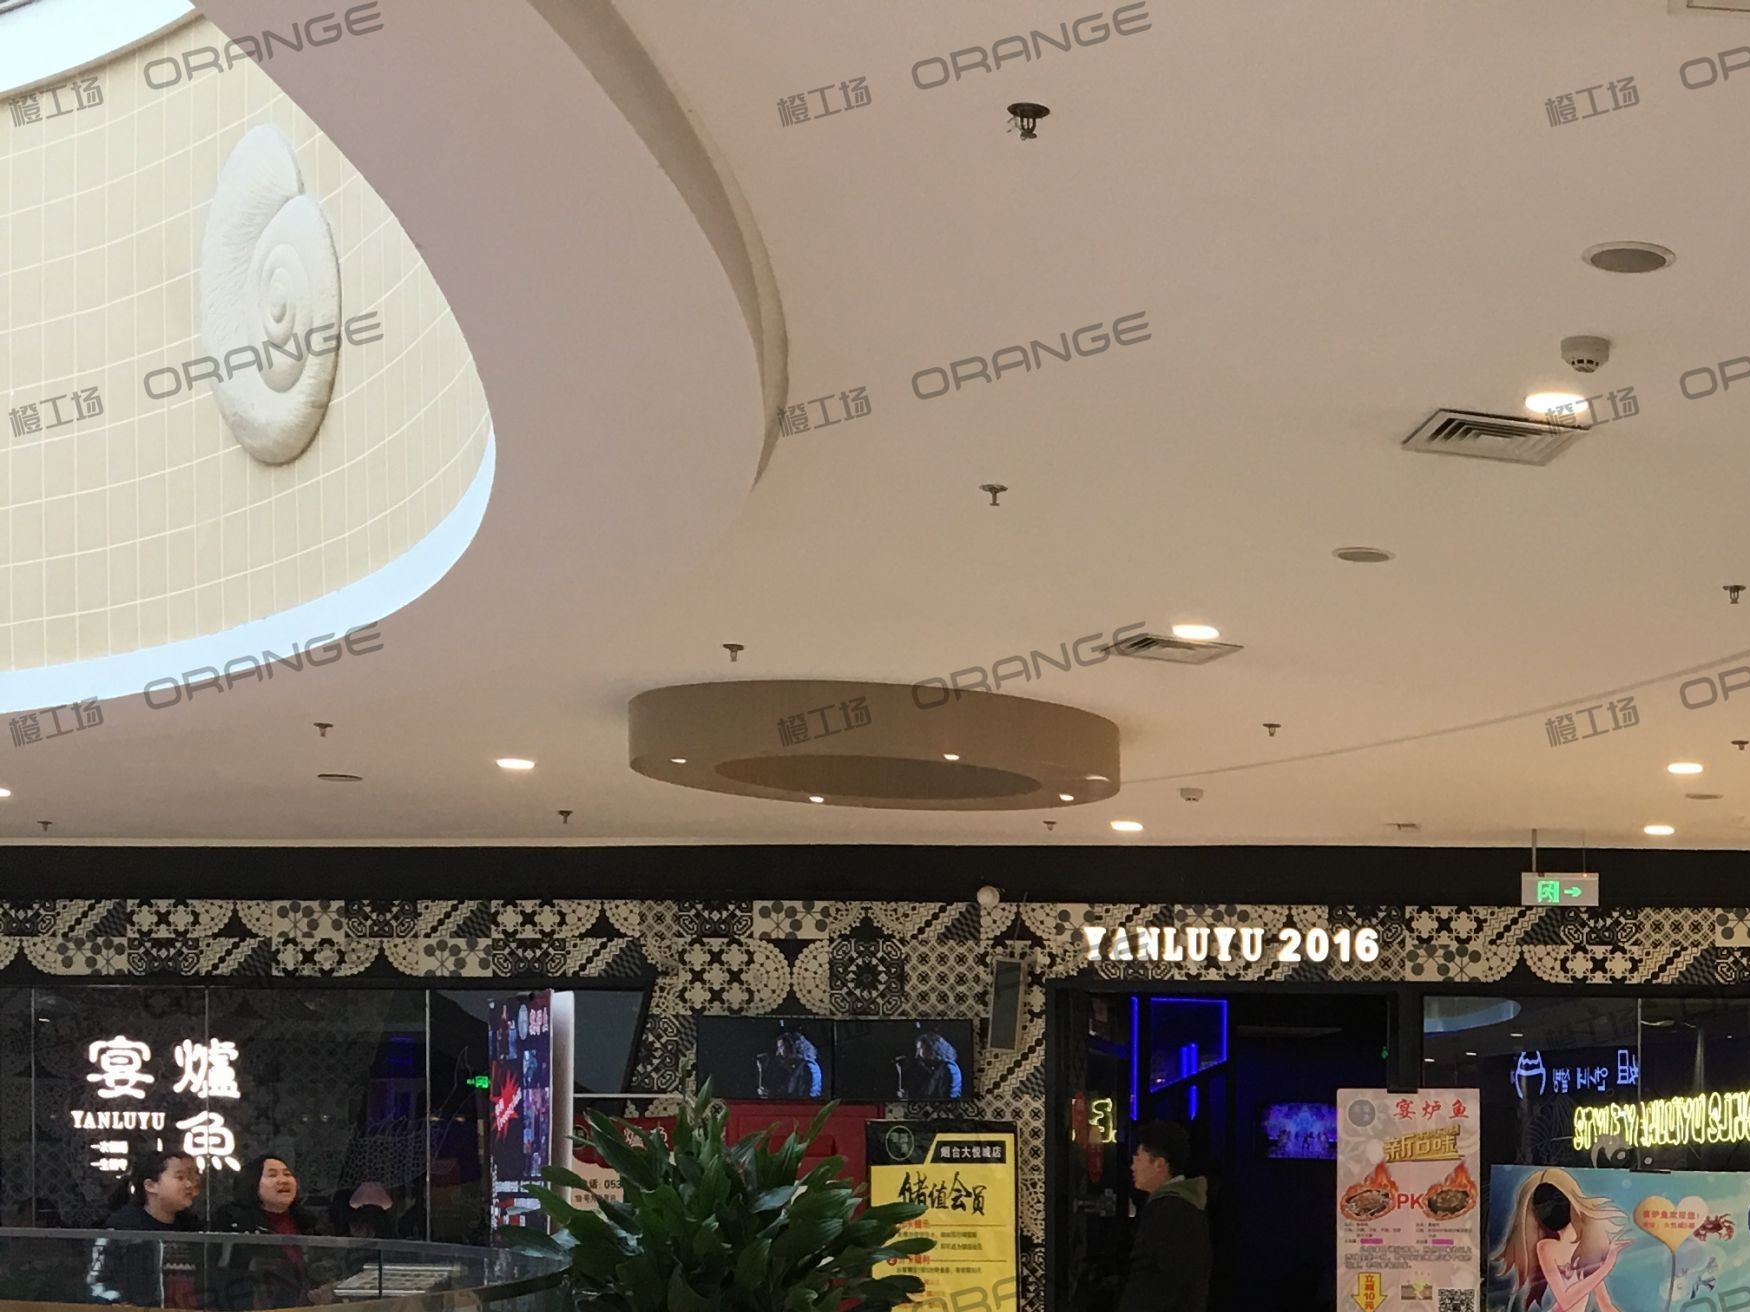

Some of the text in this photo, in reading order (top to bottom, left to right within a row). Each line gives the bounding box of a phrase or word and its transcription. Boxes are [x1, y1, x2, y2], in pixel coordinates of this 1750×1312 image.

[1084, 926, 1379, 962] YANLUYU 2016
[71, 1110, 166, 1130] YANLUYU
[1393, 1099, 1469, 1121] 宴炉鱼
[898, 1171, 988, 1216] 储值会员
[1396, 1193, 1424, 1210] PK
